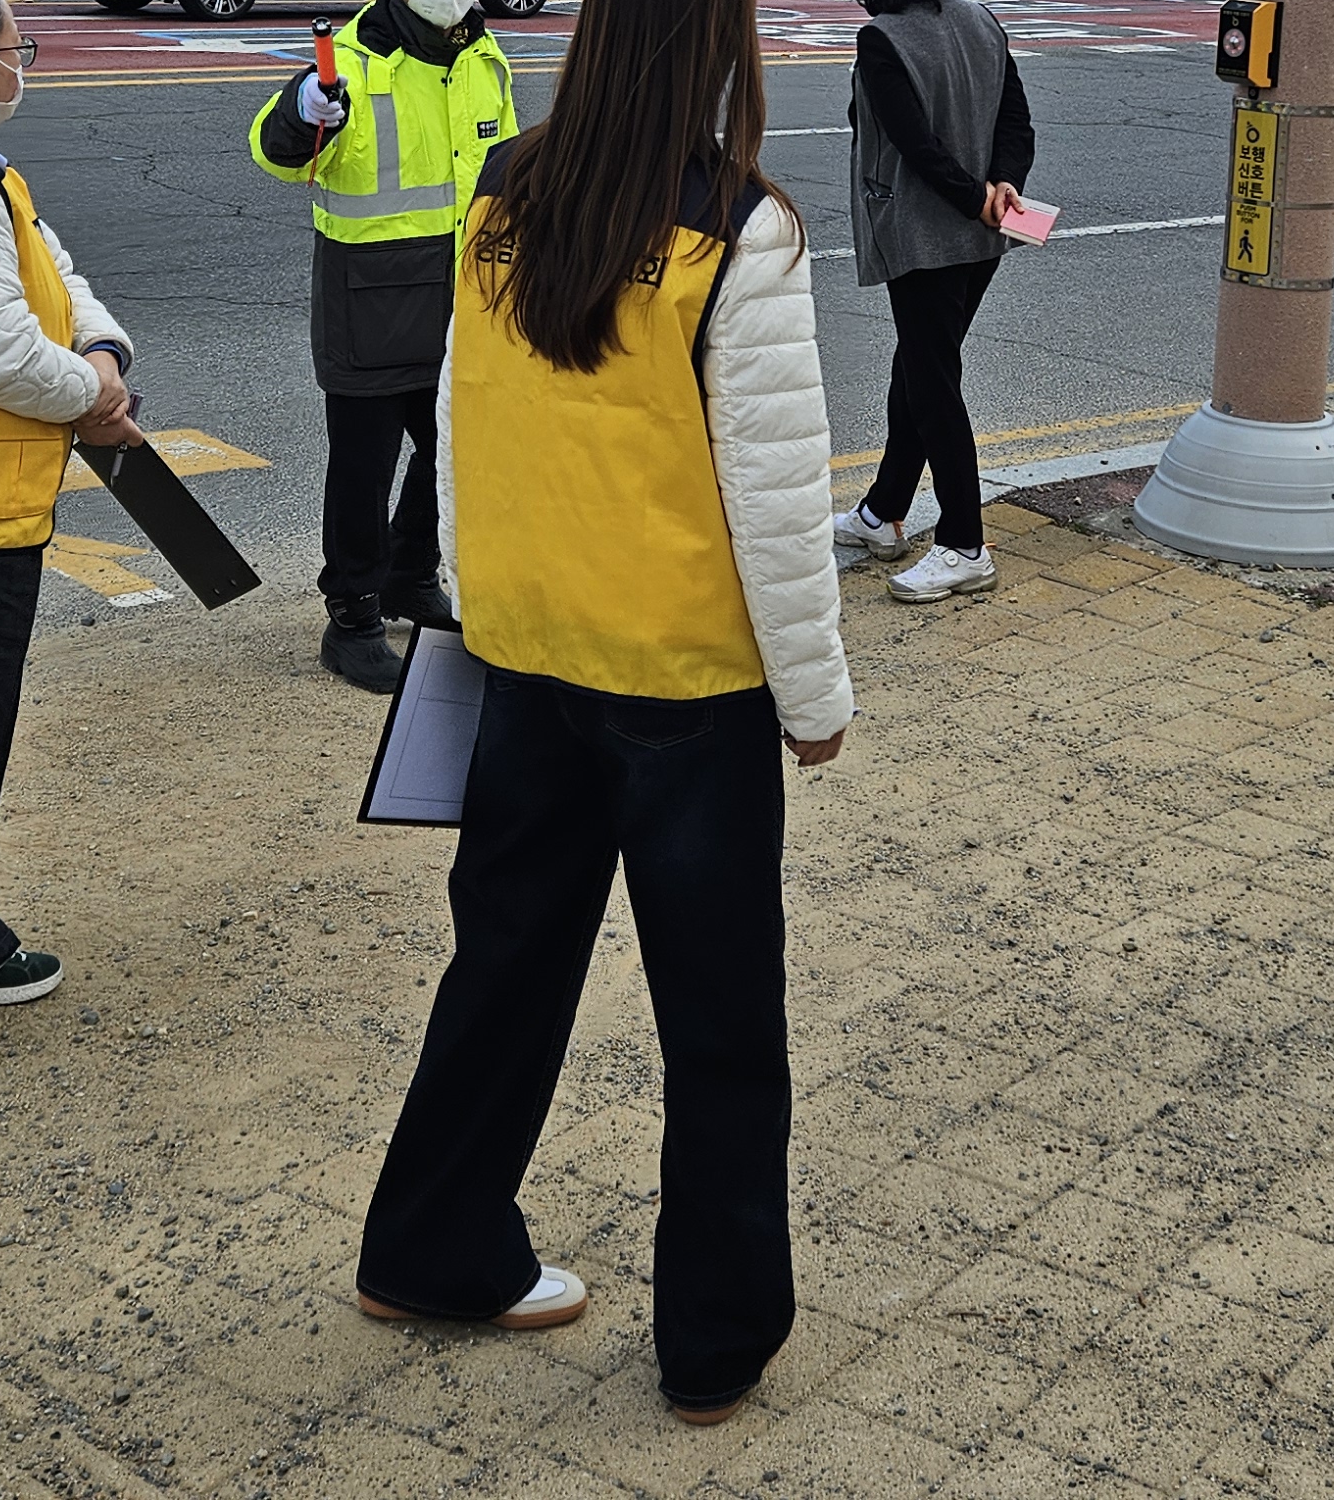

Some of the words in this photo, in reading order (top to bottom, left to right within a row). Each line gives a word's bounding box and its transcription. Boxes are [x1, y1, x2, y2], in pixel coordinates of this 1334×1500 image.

[1238, 144, 1266, 163] 보행
[1238, 162, 1265, 180] 신호
[1237, 181, 1264, 199] 버튼
